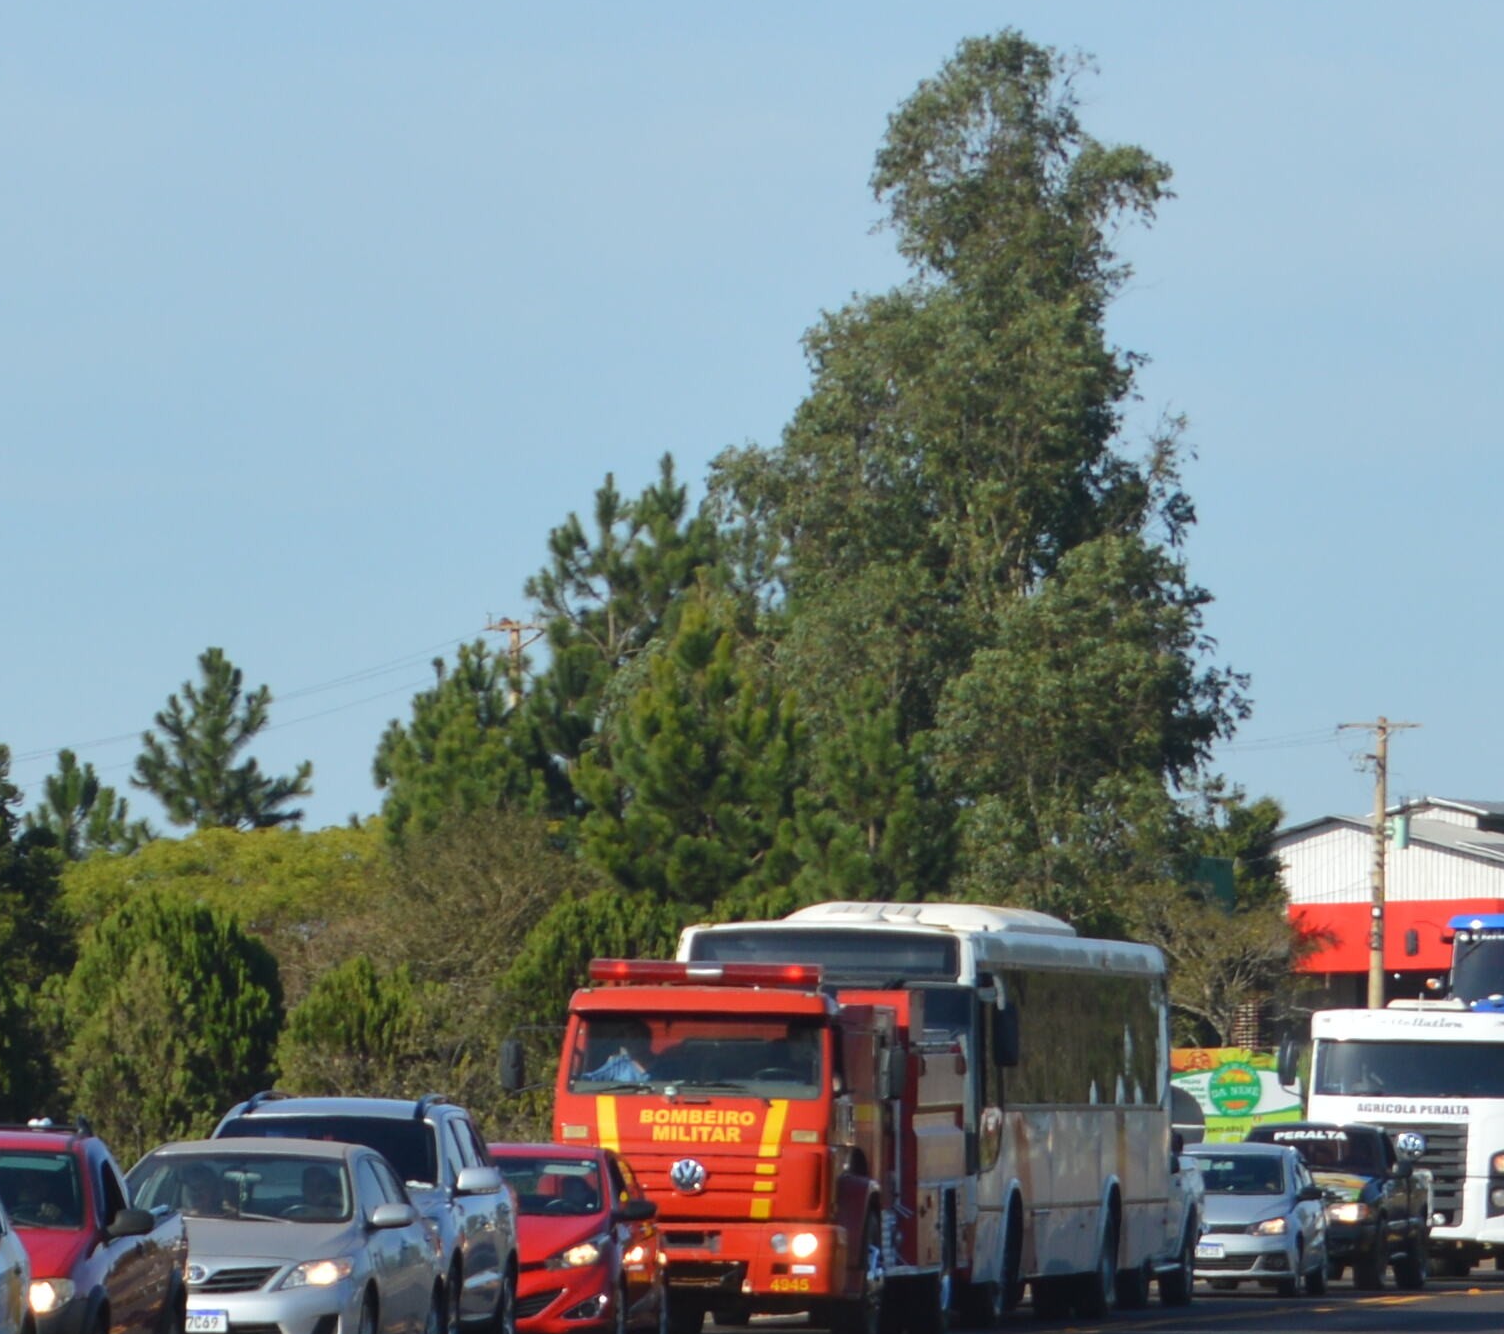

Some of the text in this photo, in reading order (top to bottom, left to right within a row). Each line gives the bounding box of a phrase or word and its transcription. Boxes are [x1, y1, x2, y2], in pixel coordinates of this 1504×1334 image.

[1357, 1103, 1470, 1115] AGRÍCOLA PERALTA
[639, 1109, 755, 1126] BOMBEIRO
[652, 1125, 741, 1142] MILITAR
[1274, 1130, 1348, 1141] PERALTA
